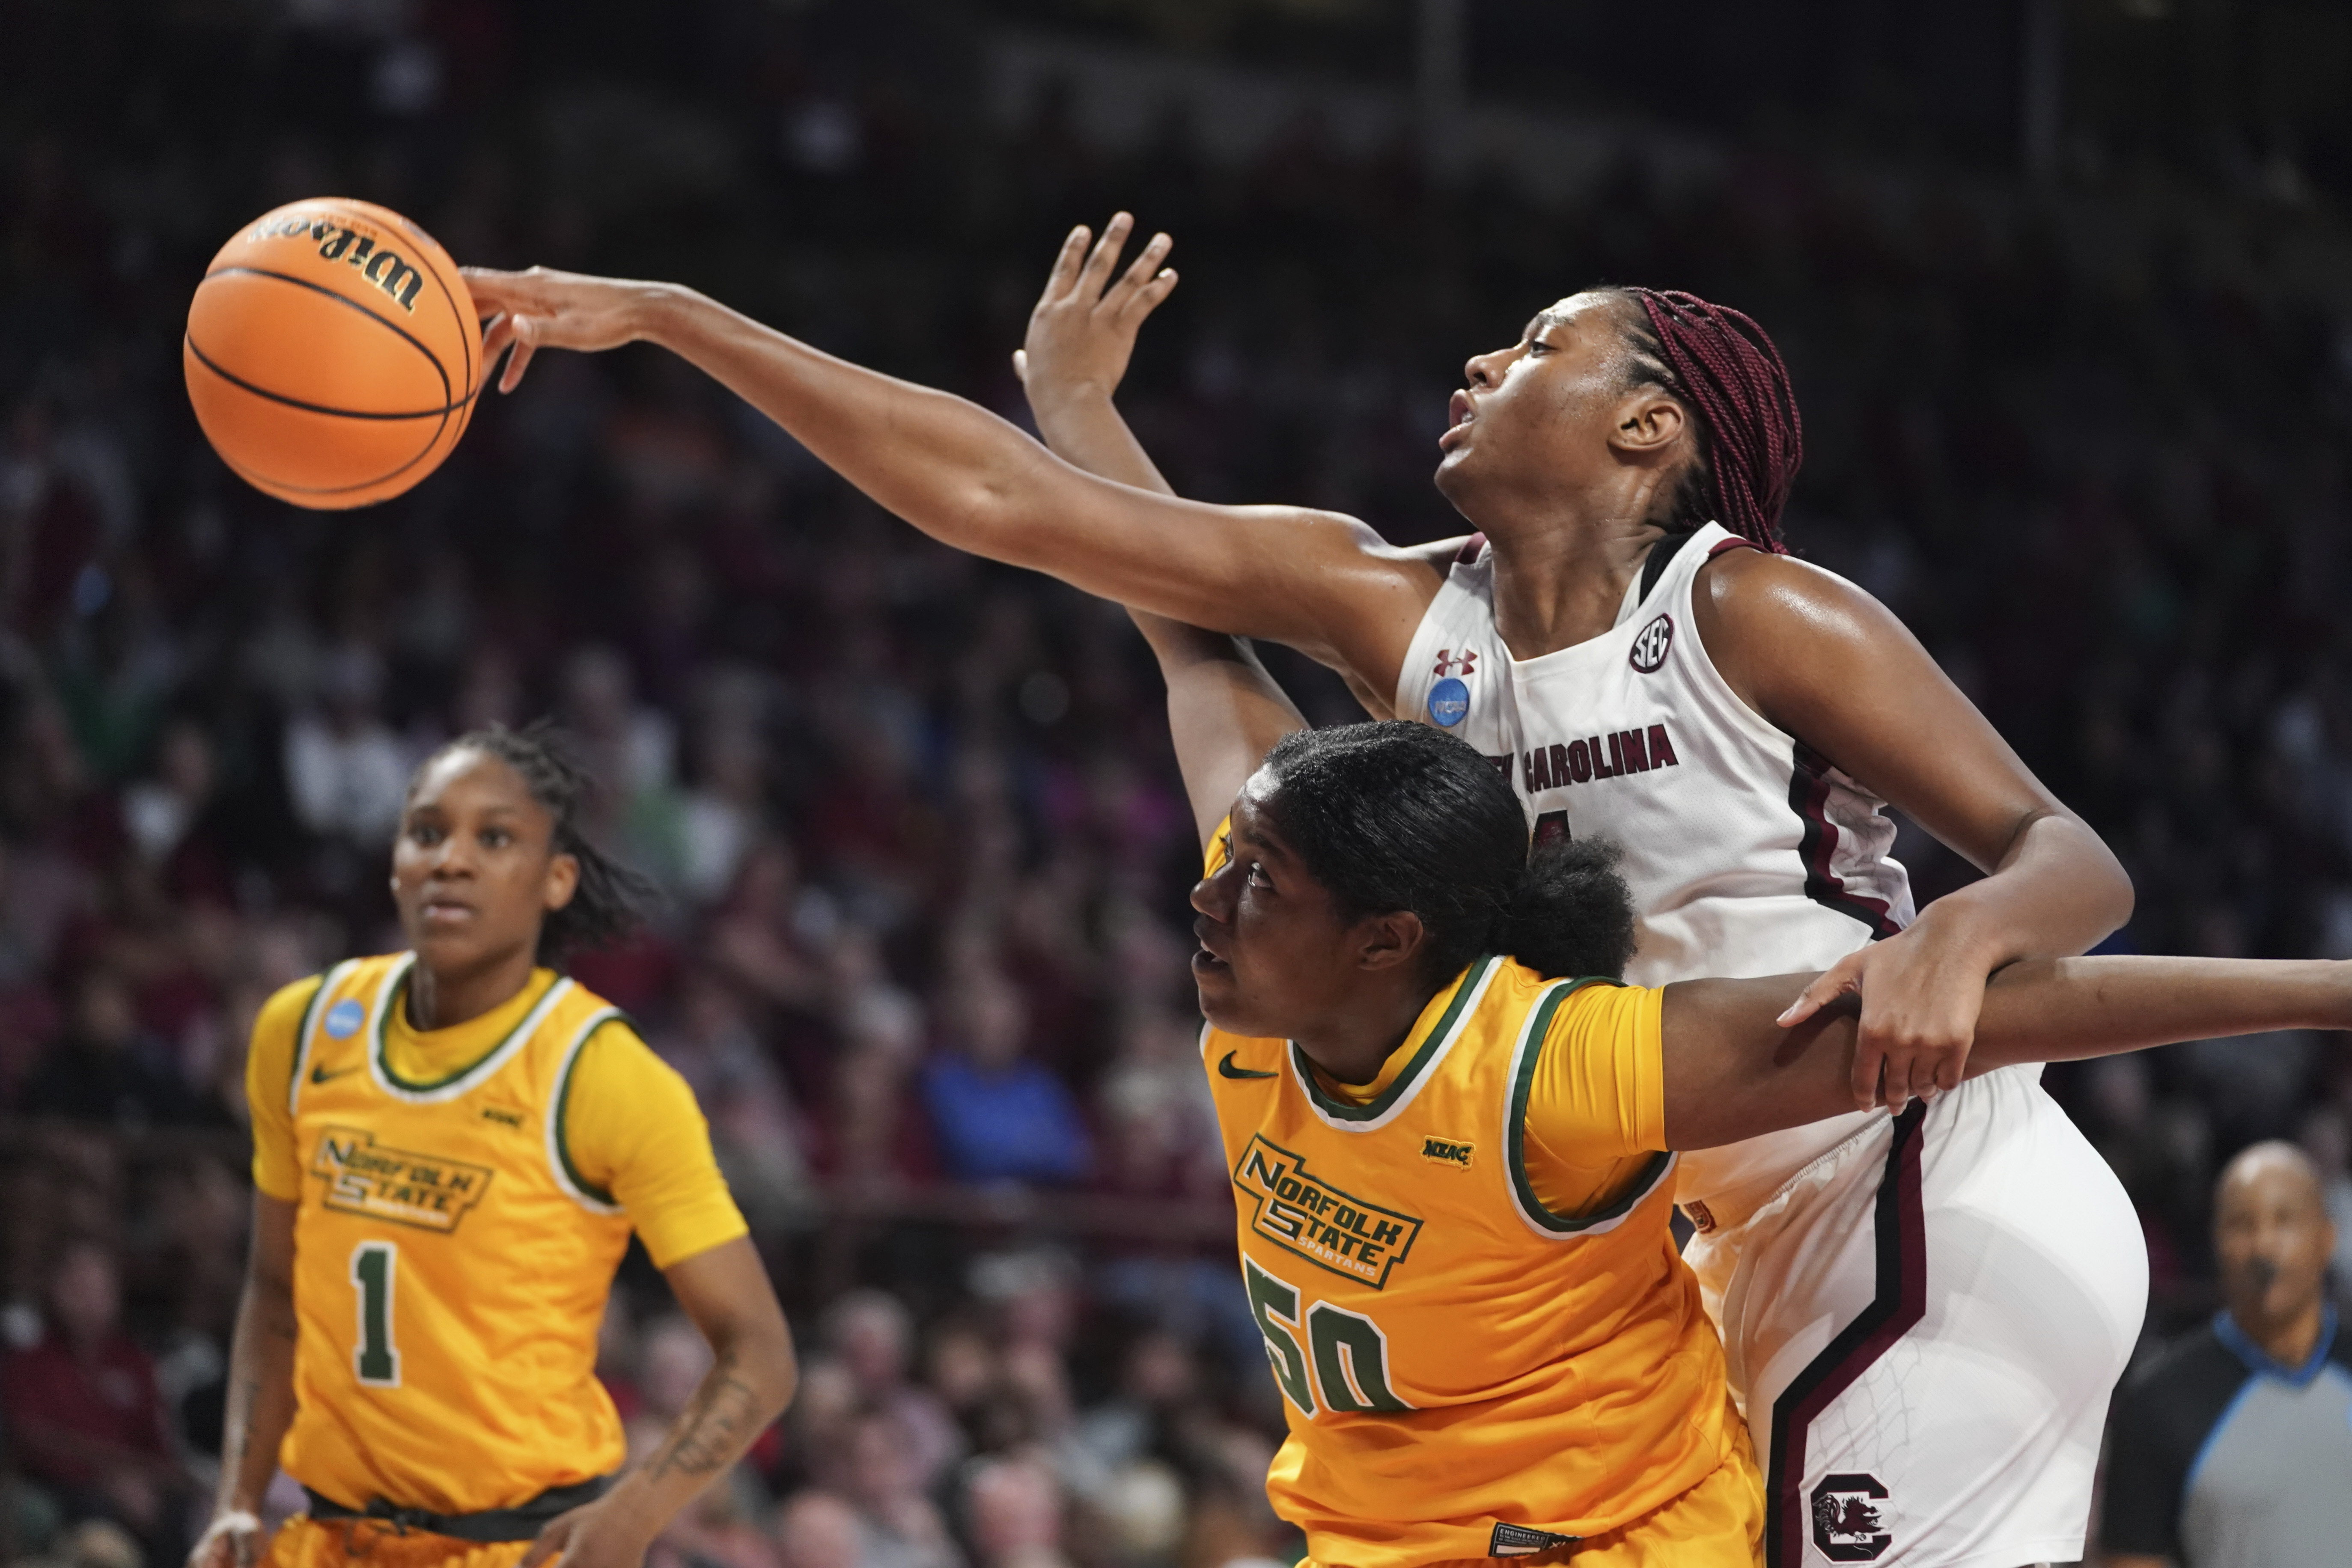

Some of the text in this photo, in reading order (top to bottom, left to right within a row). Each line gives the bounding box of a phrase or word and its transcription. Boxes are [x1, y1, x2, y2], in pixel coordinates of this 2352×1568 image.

[1633, 617, 1669, 668] SEC
[1524, 724, 1679, 794] CAROLINA
[1243, 1148, 1404, 1246] NORFOLK
[1261, 1198, 1385, 1267] STATE
[1298, 1236, 1377, 1277] SPARTANS
[349, 1241, 400, 1388] 1
[1243, 1251, 1423, 1420] 50
